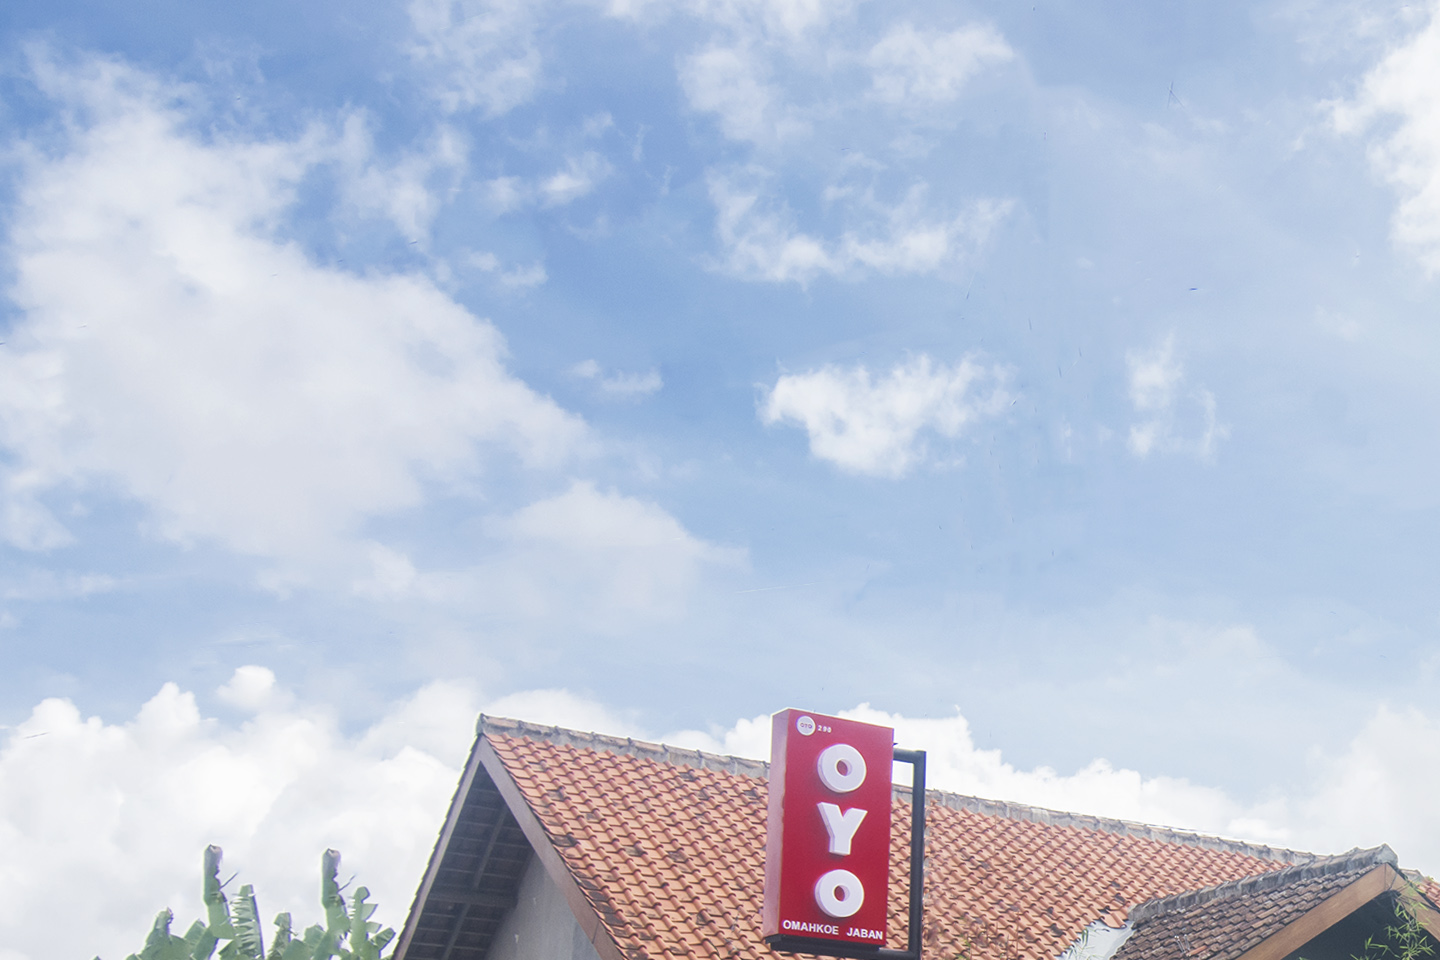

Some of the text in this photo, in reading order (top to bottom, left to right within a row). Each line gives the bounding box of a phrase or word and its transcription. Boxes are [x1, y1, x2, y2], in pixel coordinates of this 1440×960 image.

[815, 743, 868, 918] OYO
[782, 919, 884, 940] OMAHKOE JABAN
